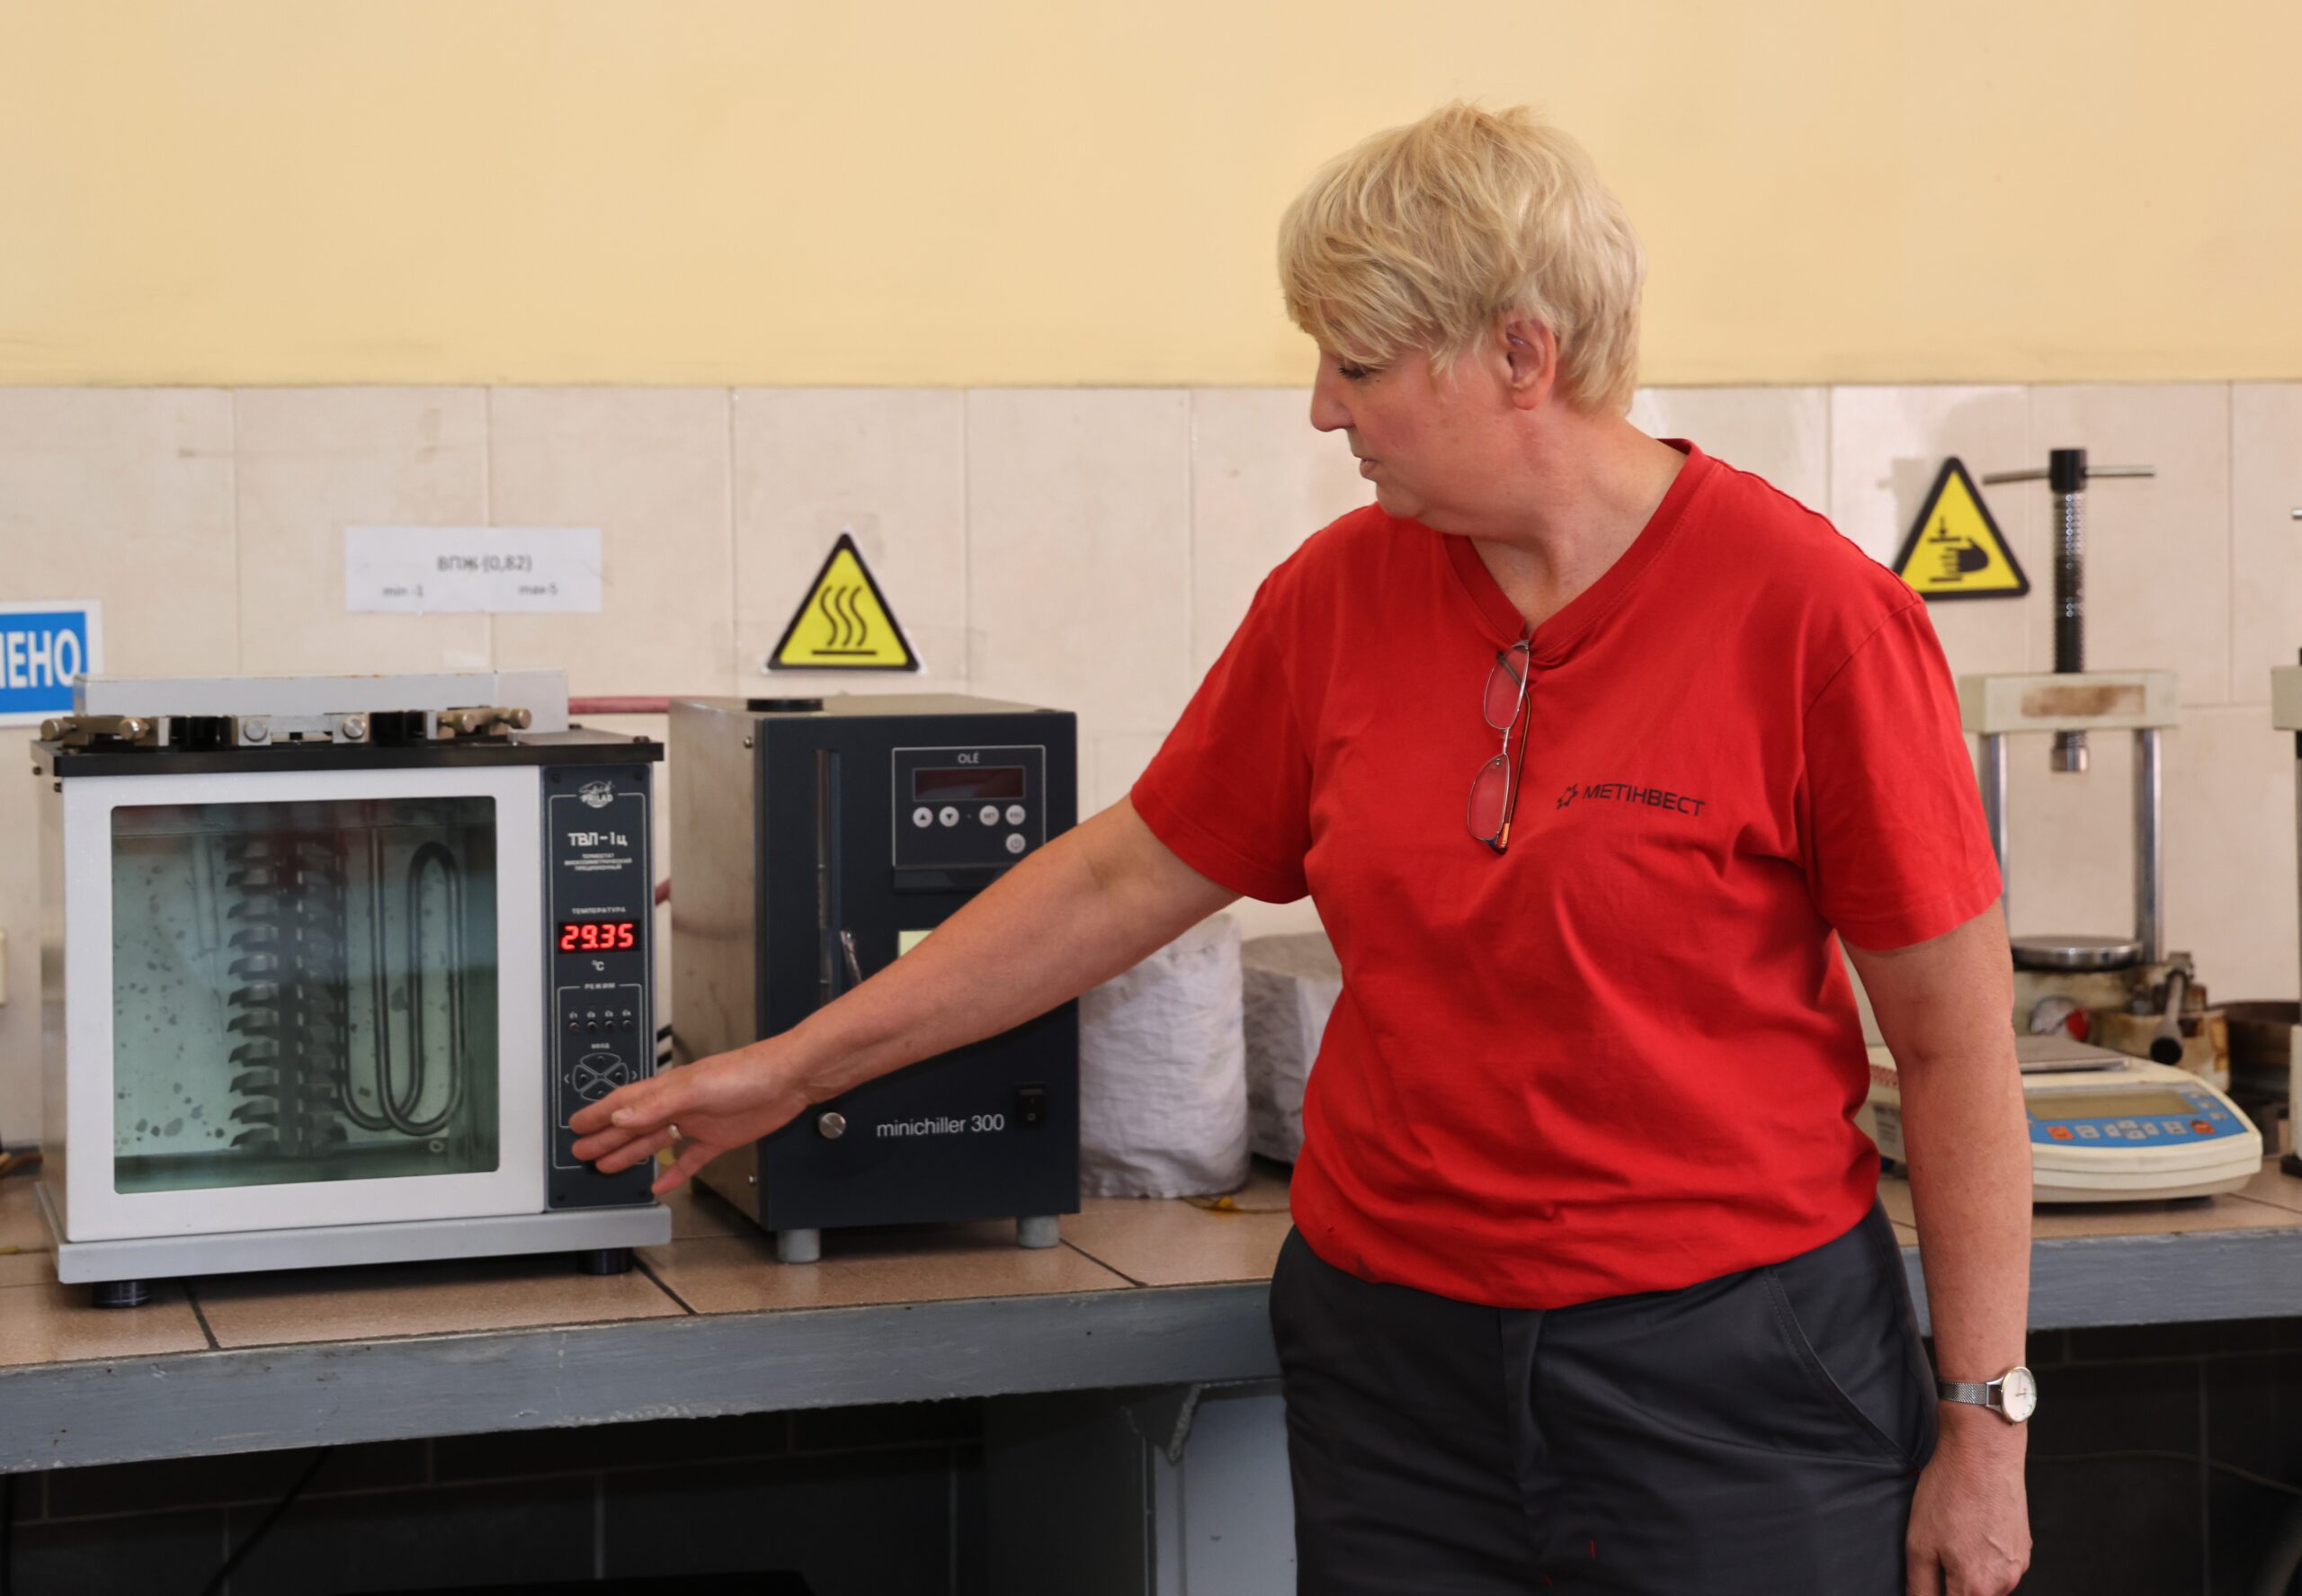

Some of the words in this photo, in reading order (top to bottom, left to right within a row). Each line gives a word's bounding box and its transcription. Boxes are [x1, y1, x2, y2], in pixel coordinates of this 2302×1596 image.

[0, 628, 82, 690] ЕНО
[958, 751, 980, 764] OLÉ
[1583, 783, 1706, 816] МЕТІНВЕСТ
[877, 1117, 967, 1137] minichiller
[971, 1114, 1004, 1132] 300
